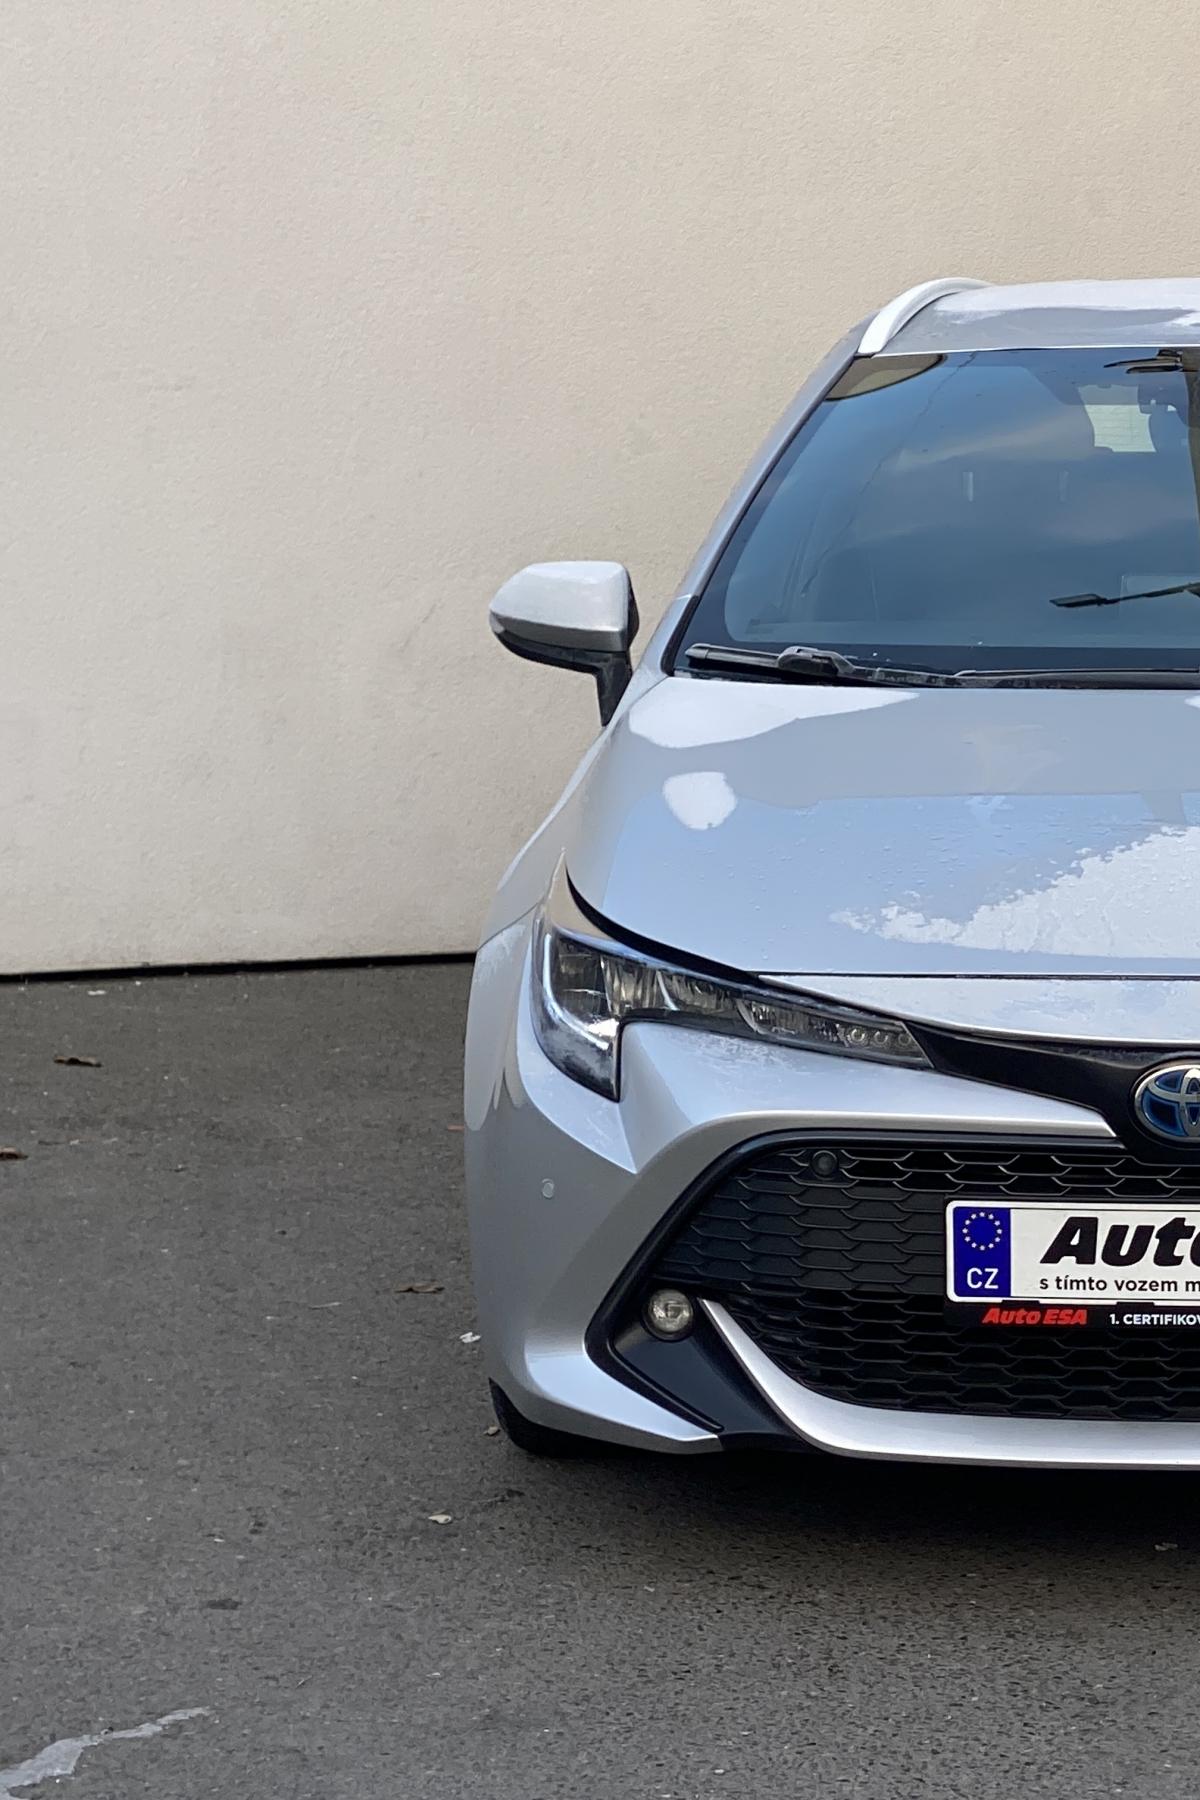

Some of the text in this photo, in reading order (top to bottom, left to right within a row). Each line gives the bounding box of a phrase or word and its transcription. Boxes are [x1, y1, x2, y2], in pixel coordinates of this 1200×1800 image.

[966, 1267, 1000, 1290] CZ
[1039, 1278, 1049, 1291] s
[1054, 1274, 1108, 1292] tímto
[1114, 1279, 1178, 1293] vozem
[1109, 1313, 1120, 1325] 1.
